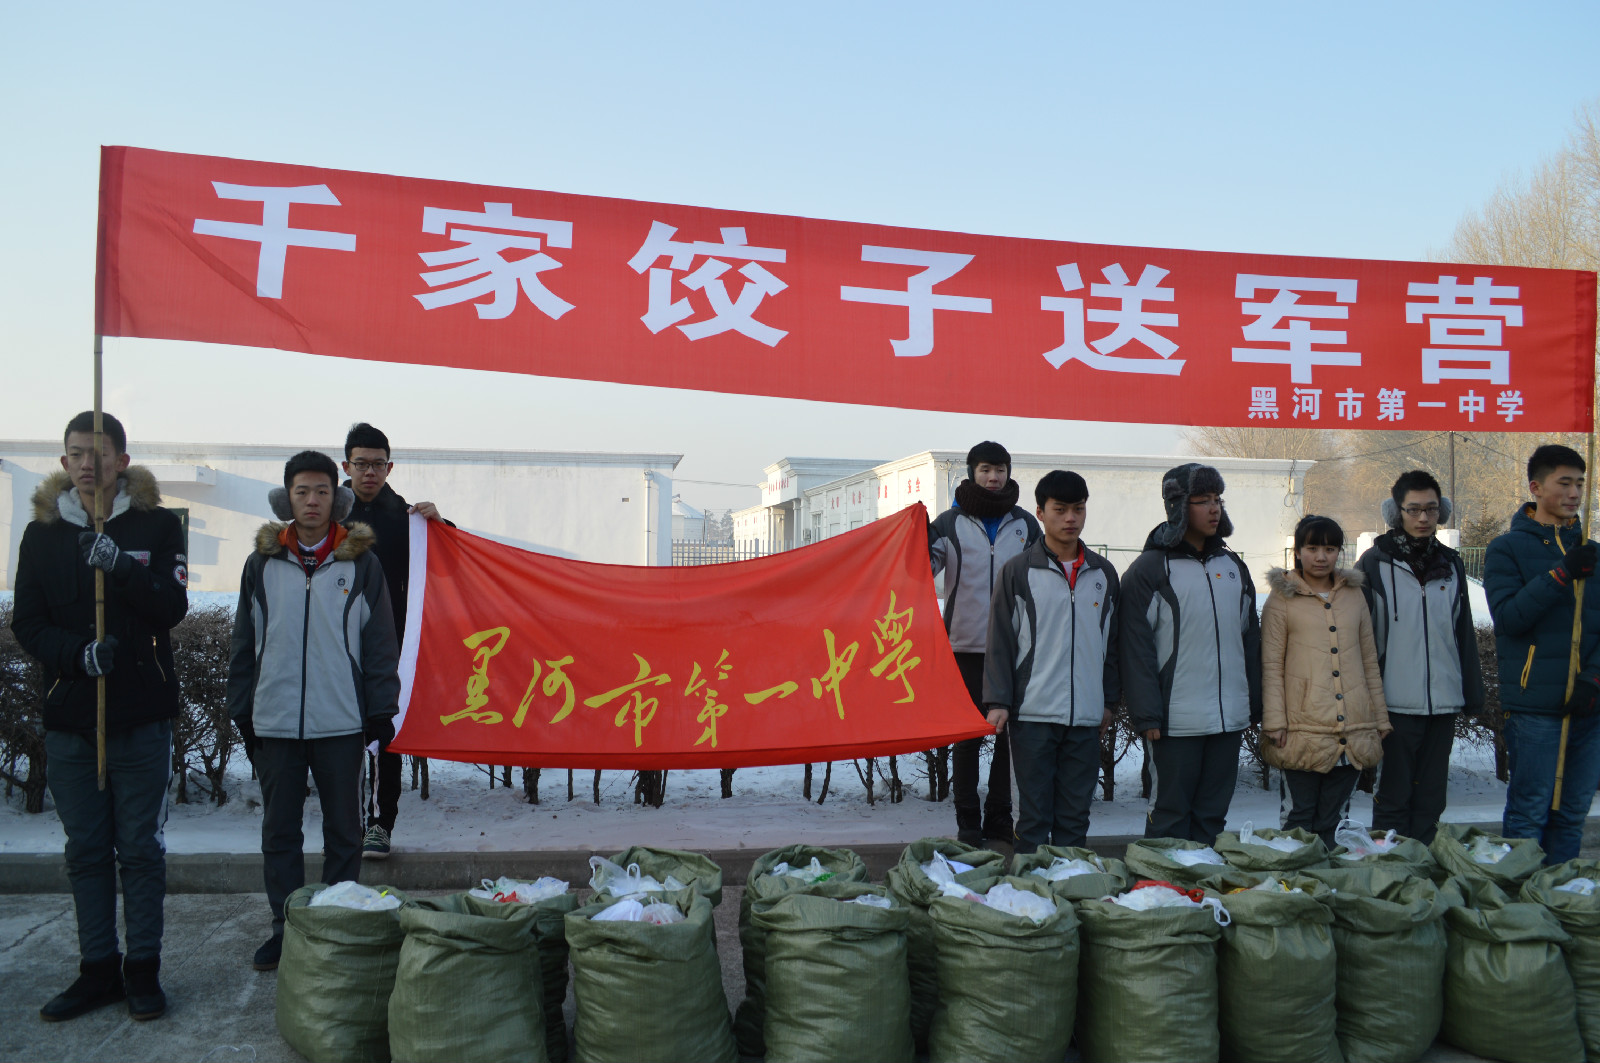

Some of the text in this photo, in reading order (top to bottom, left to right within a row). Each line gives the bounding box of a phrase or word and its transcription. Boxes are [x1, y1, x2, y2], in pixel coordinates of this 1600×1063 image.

[193, 181, 1523, 386] 千家饺子送军营
[1248, 386, 1524, 423] 黑河市第一中学
